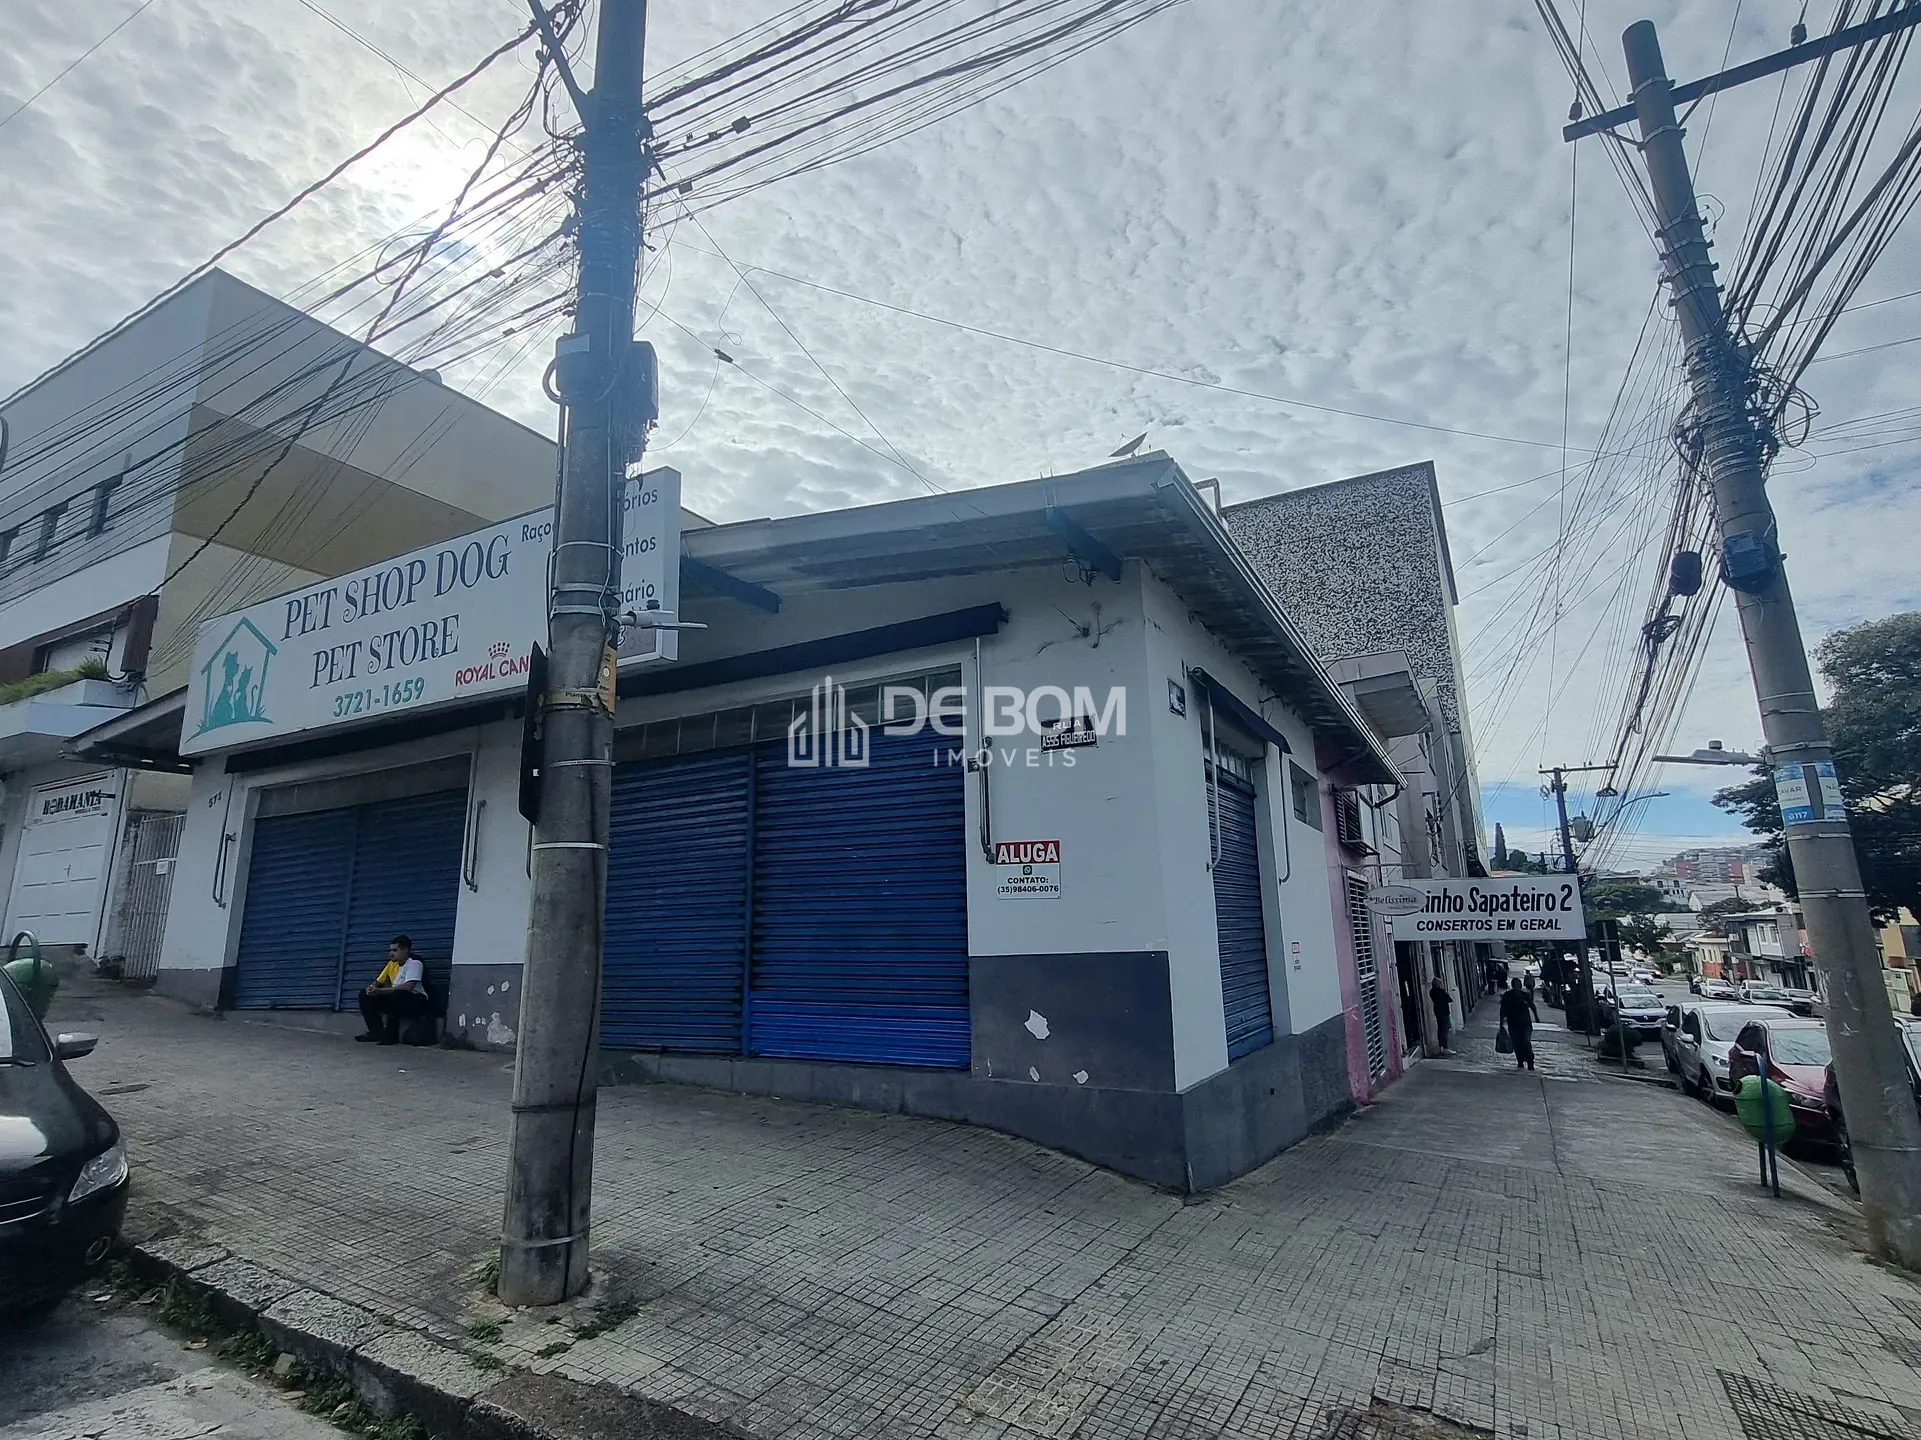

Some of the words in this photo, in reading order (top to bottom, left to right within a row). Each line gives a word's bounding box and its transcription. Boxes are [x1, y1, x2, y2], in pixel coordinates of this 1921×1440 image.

[623, 489, 658, 512] órios
[624, 536, 656, 557] ntos
[280, 587, 338, 642] PET
[342, 559, 427, 623] SHOP
[433, 534, 512, 597] DOG
[309, 641, 363, 689] PET
[367, 613, 460, 674] STORE
[455, 662, 495, 686] ROYAL
[499, 654, 530, 677] CAN
[333, 676, 425, 717] 3721-1659
[1052, 719, 1082, 731] RUA
[1041, 734, 1060, 748] ASSIS
[997, 843, 1058, 864] ALUGA
[997, 885, 1059, 894] (35)98406-0076
[1007, 876, 1049, 884] CONTATO:
[1420, 888, 1464, 913] inho
[1468, 884, 1557, 917] Sapateiro
[1560, 884, 1573, 911] 2
[1416, 919, 1493, 932] CONSERTOS
[1497, 918, 1516, 931] EM
[1519, 918, 1562, 931] GERAL
